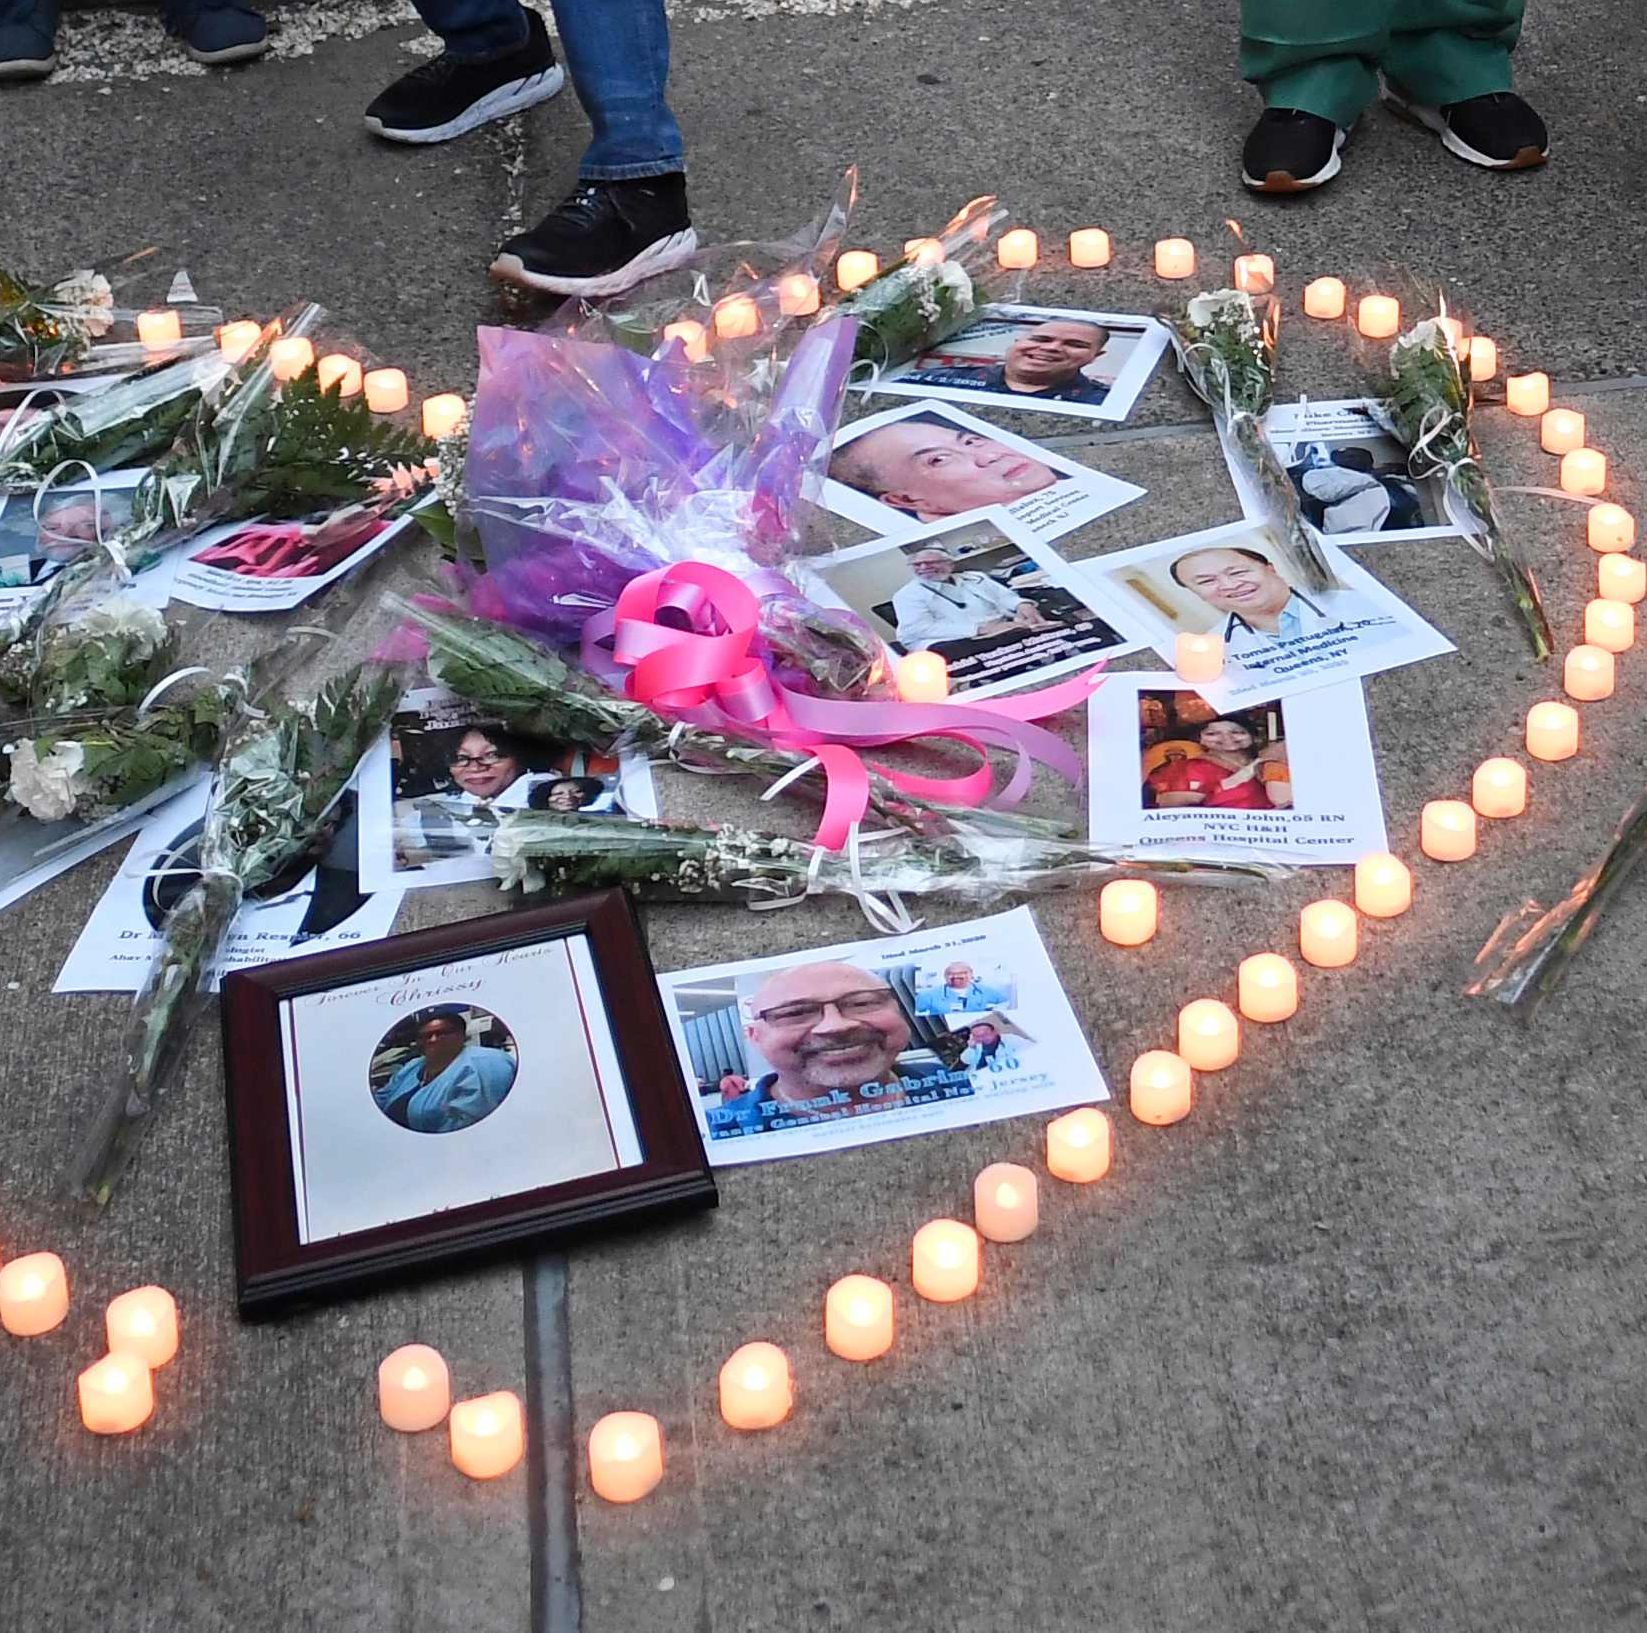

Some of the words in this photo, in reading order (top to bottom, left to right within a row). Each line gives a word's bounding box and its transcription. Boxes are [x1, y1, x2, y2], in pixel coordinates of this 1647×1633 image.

[1231, 645, 1278, 661] Tomas
[1242, 651, 1297, 670] Internal
[1297, 634, 1359, 655] Medicine
[1273, 654, 1330, 674] Queens,
[1329, 647, 1349, 659] NY
[1143, 811, 1238, 823] Aleyamma
[1320, 814, 1346, 823] RN
[1203, 822, 1240, 831] NYC
[1245, 824, 1288, 834] H&H
[1139, 834, 1206, 847] Queens
[1212, 834, 1289, 845] Hospital
[1294, 836, 1355, 845] Center
[118, 930, 142, 940] Dr
[337, 930, 362, 940] 66
[305, 984, 380, 1006] Forever
[482, 947, 553, 967] Hearts
[376, 977, 487, 1007] Chrissy
[710, 1108, 749, 1124] Dr
[759, 1088, 852, 1117] Frank
[770, 1109, 851, 1130] General
[854, 1087, 941, 1115] Hospital
